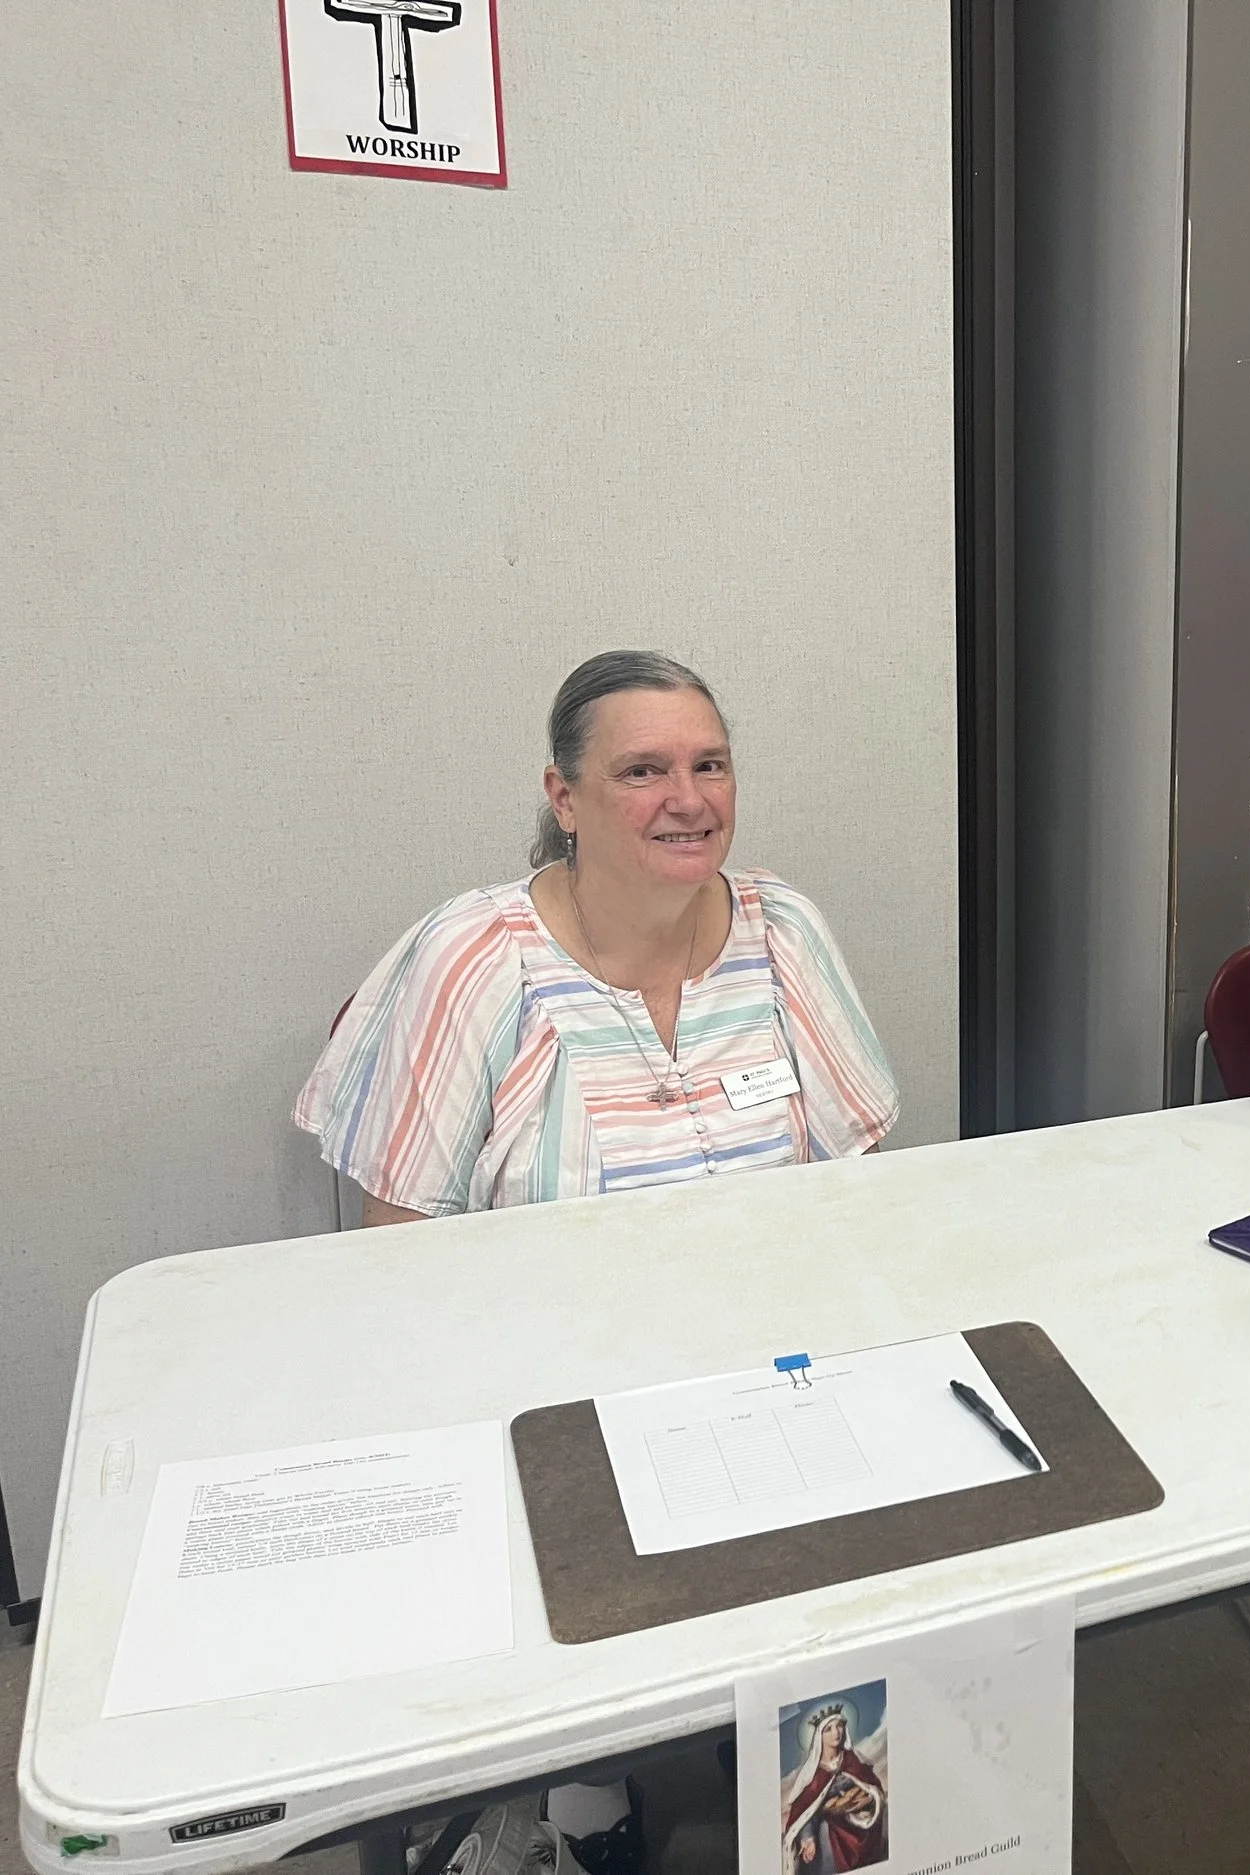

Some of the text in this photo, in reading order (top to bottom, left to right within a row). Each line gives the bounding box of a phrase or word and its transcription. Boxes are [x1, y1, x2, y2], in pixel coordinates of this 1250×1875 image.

[346, 134, 460, 163] WORSHIP
[729, 1074, 793, 1098] Mary Ellen Hartford
[186, 1809, 272, 1837] LIFETIME
[954, 1846, 988, 1866] Bread
[990, 1834, 1021, 1854] Guild
